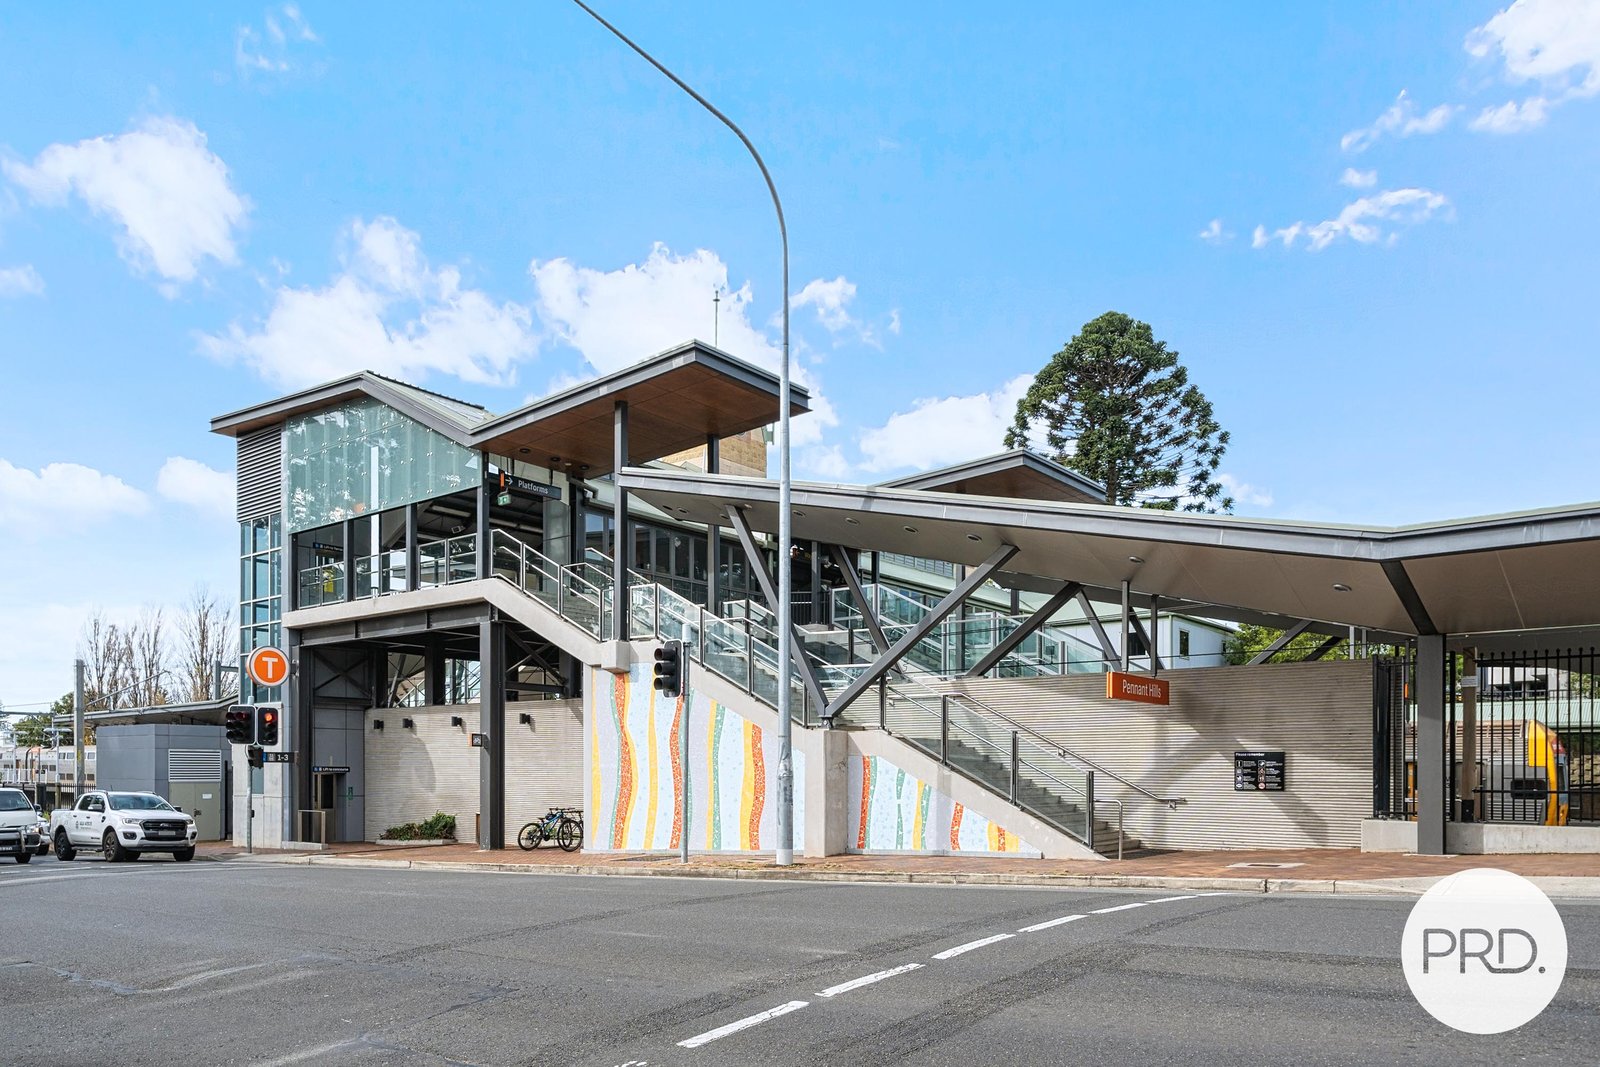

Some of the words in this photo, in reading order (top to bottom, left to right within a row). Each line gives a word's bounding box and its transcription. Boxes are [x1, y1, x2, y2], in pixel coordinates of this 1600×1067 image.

[518, 479, 549, 495] Platforms
[262, 656, 278, 679] T
[1123, 679, 1149, 697] Pennant
[1149, 684, 1162, 699] Hills
